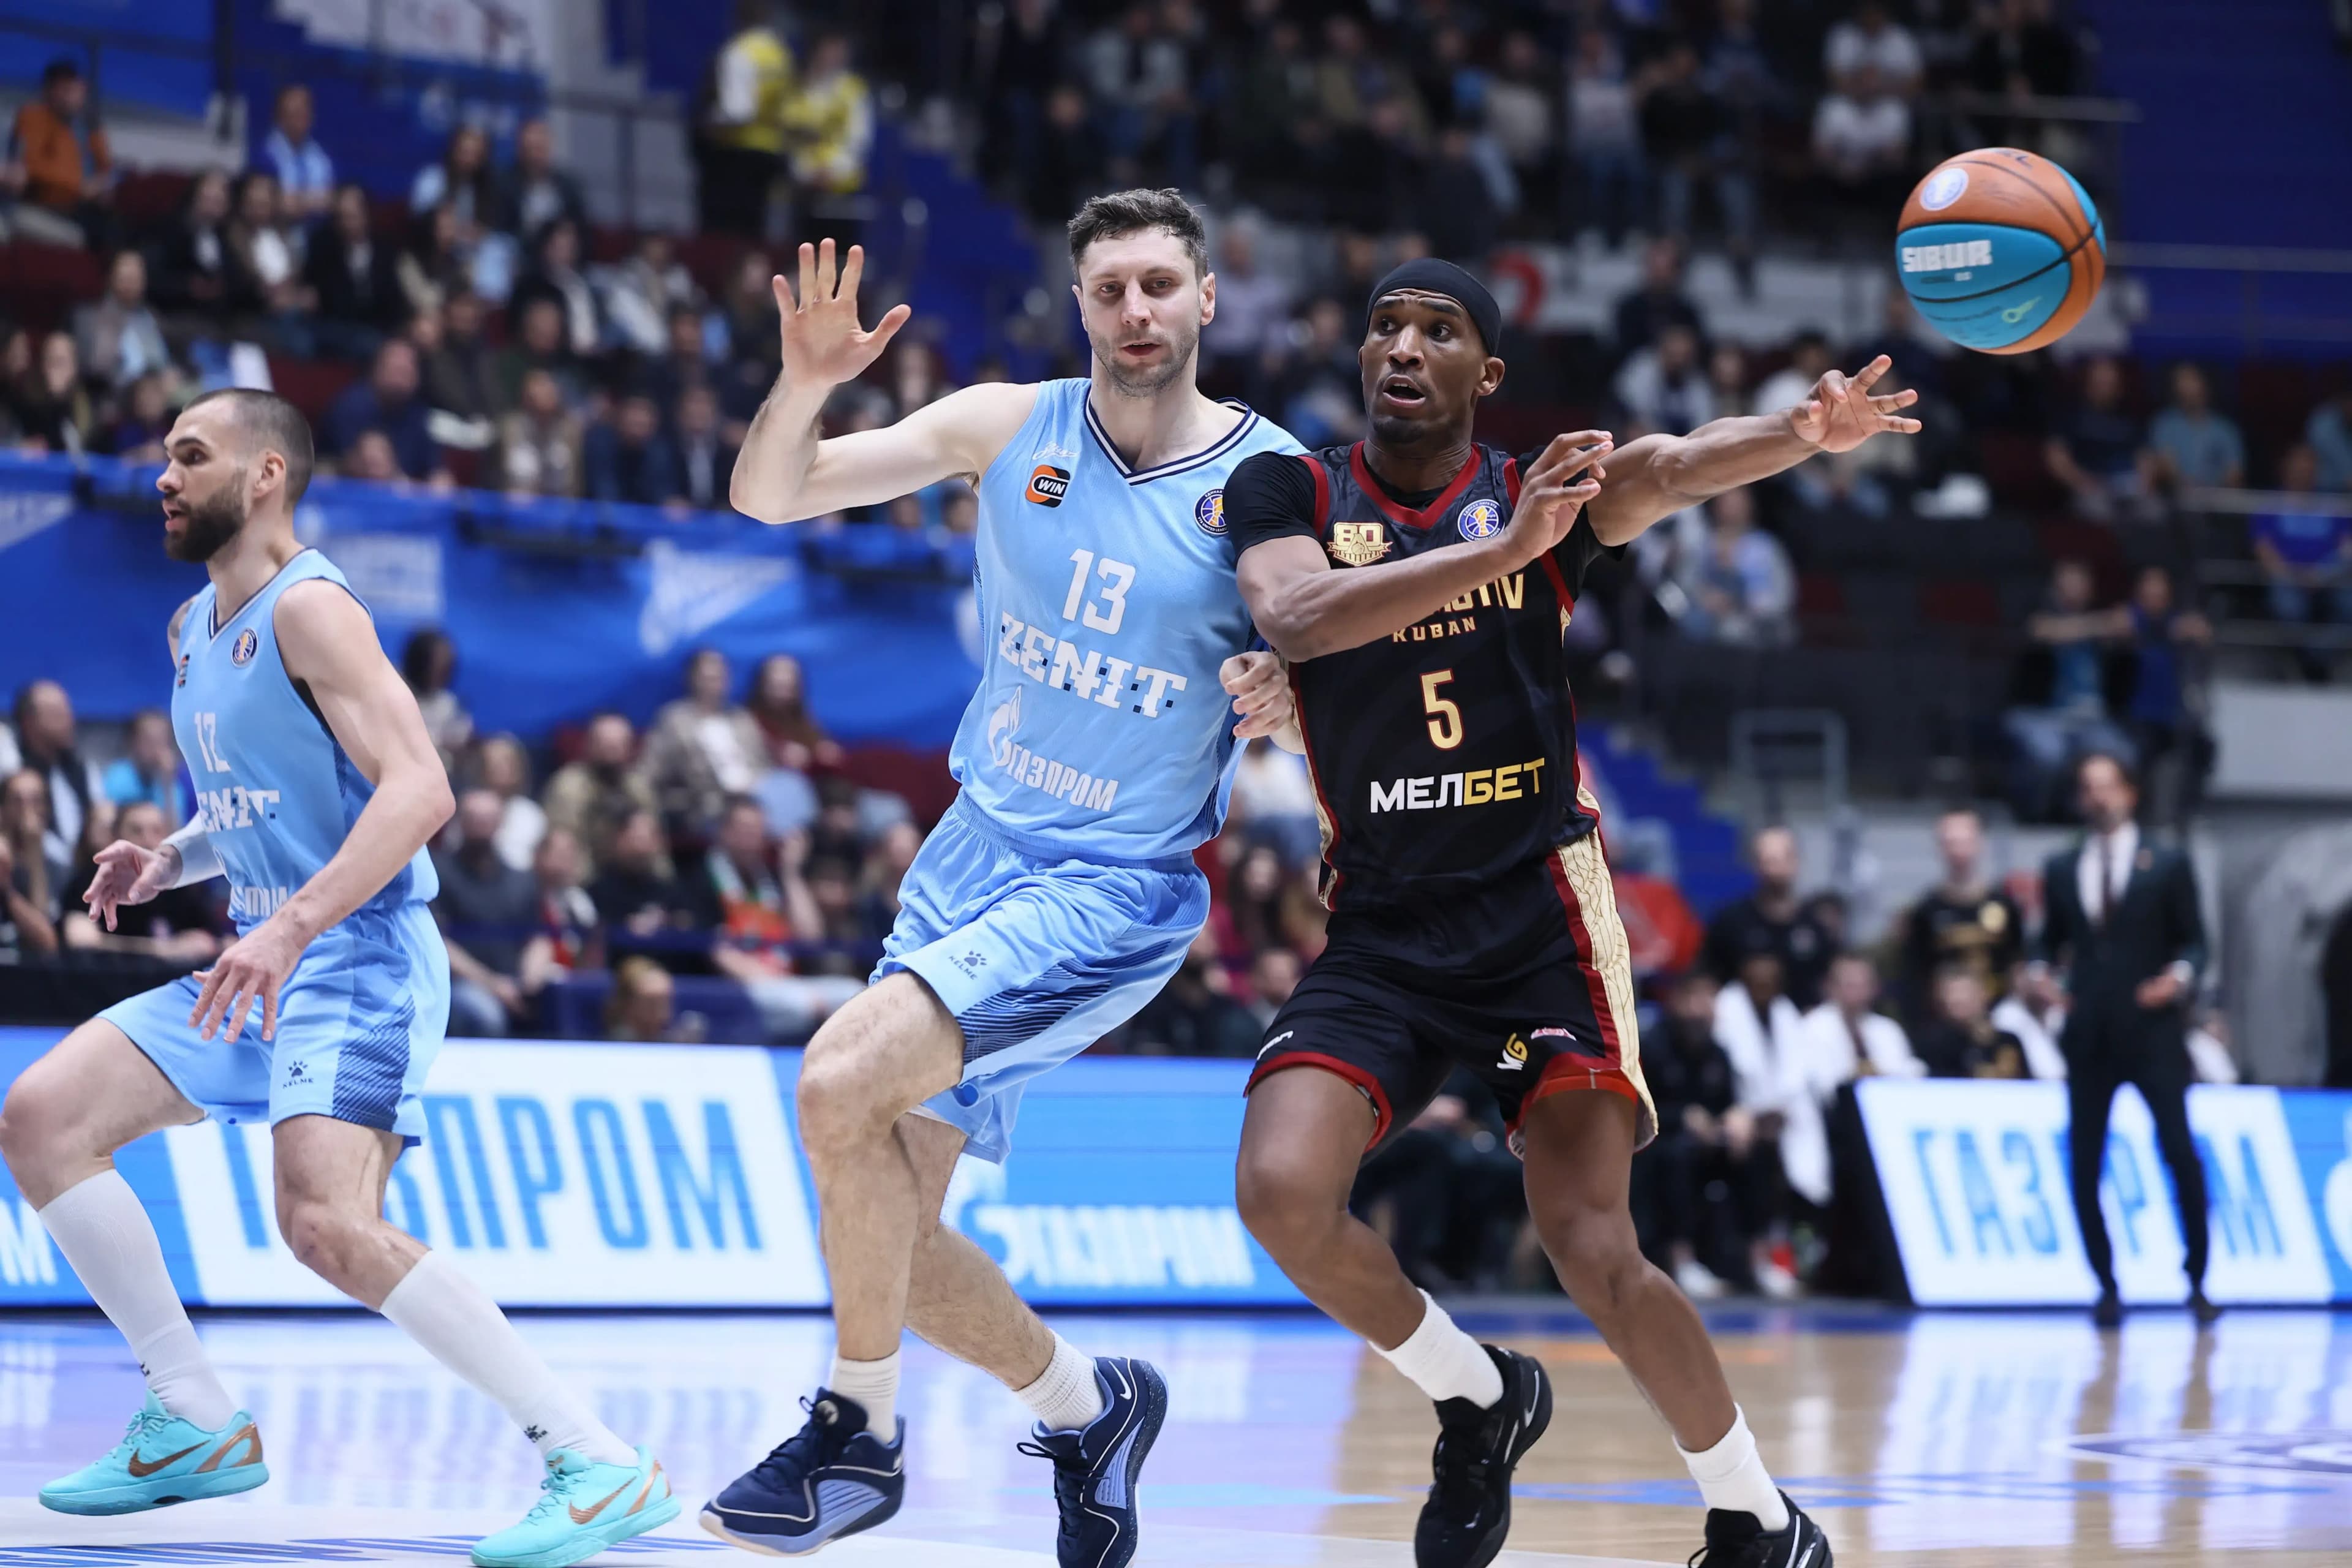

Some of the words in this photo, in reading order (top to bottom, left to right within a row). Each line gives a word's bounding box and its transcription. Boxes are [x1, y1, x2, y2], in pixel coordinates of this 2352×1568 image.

[1902, 239, 1992, 273] SIBUR
[1038, 479, 1066, 494] WIN
[1063, 548, 1136, 635] 13
[1393, 617, 1477, 643] KUBAN
[999, 611, 1188, 718] ZENIT
[1420, 668, 1464, 750] 5
[194, 712, 232, 773] 12
[1008, 743, 1119, 812] ГАЗПРОМ
[1370, 757, 1545, 813] МЕЛБЕТ
[197, 786, 281, 834] ENIT
